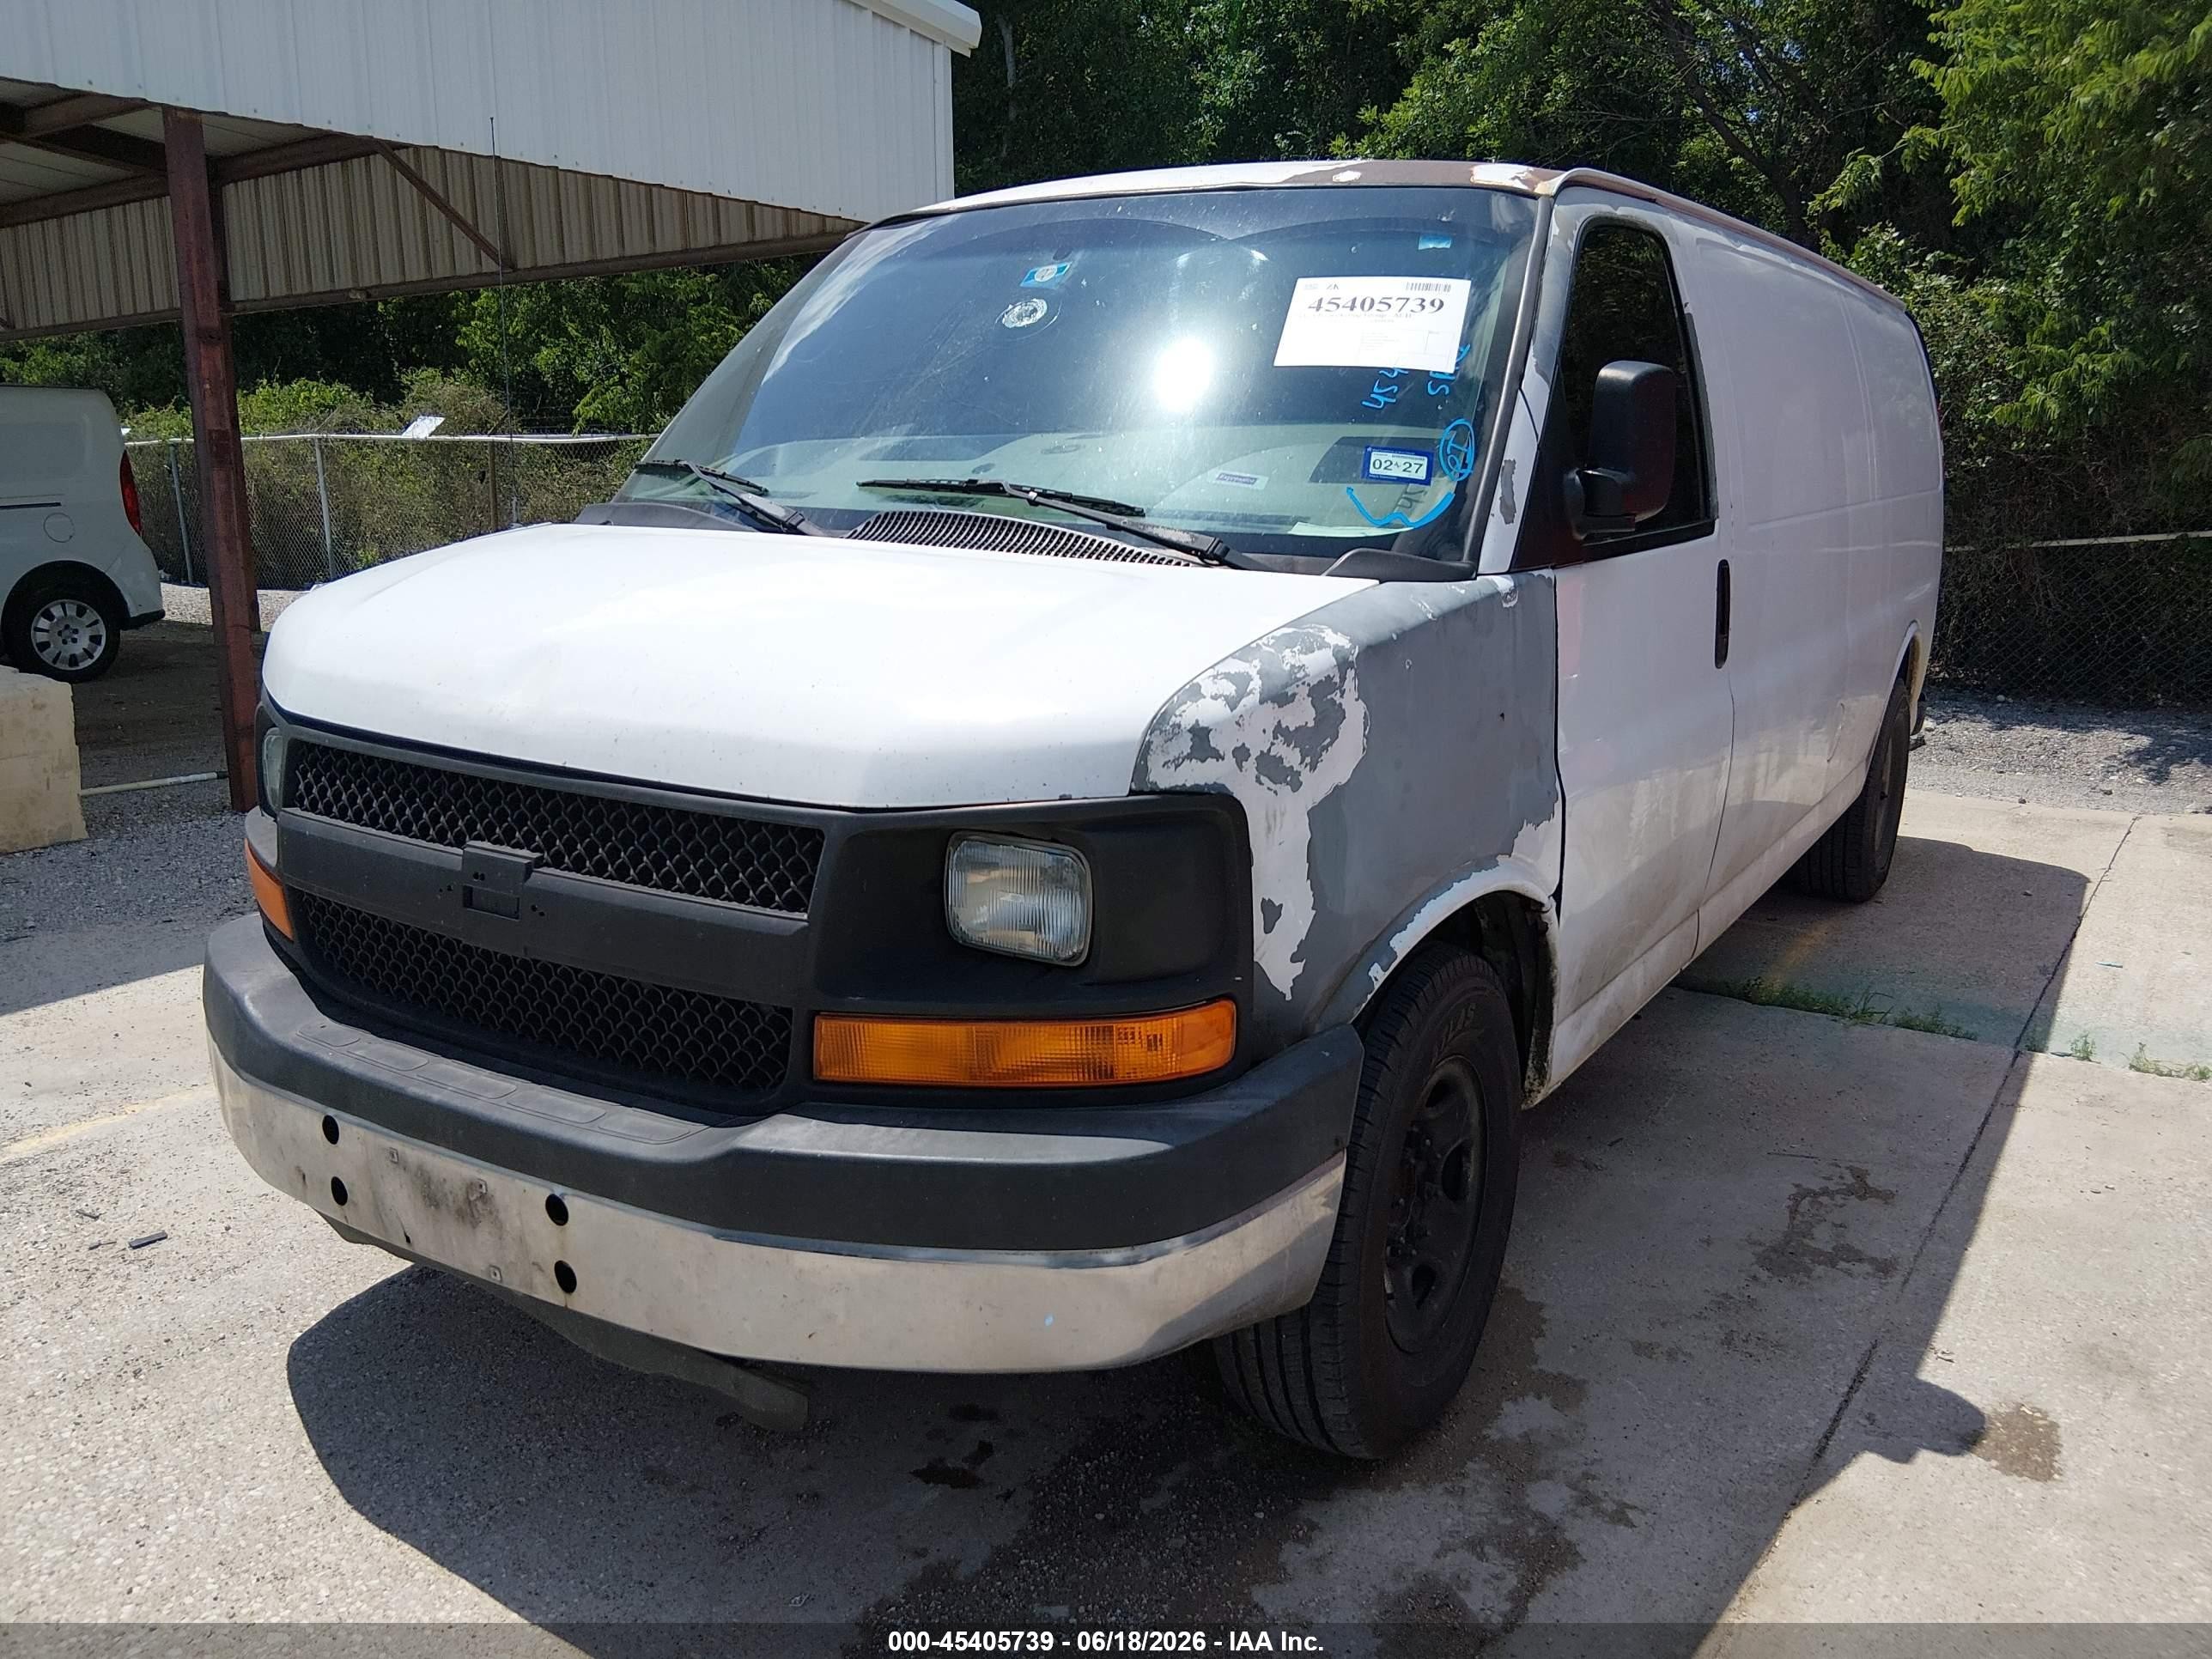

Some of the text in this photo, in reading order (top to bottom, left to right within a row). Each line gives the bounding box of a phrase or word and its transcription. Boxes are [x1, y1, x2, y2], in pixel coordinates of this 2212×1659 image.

[1307, 295, 1445, 314] 45405739
[1371, 458, 1424, 474] 02 27
